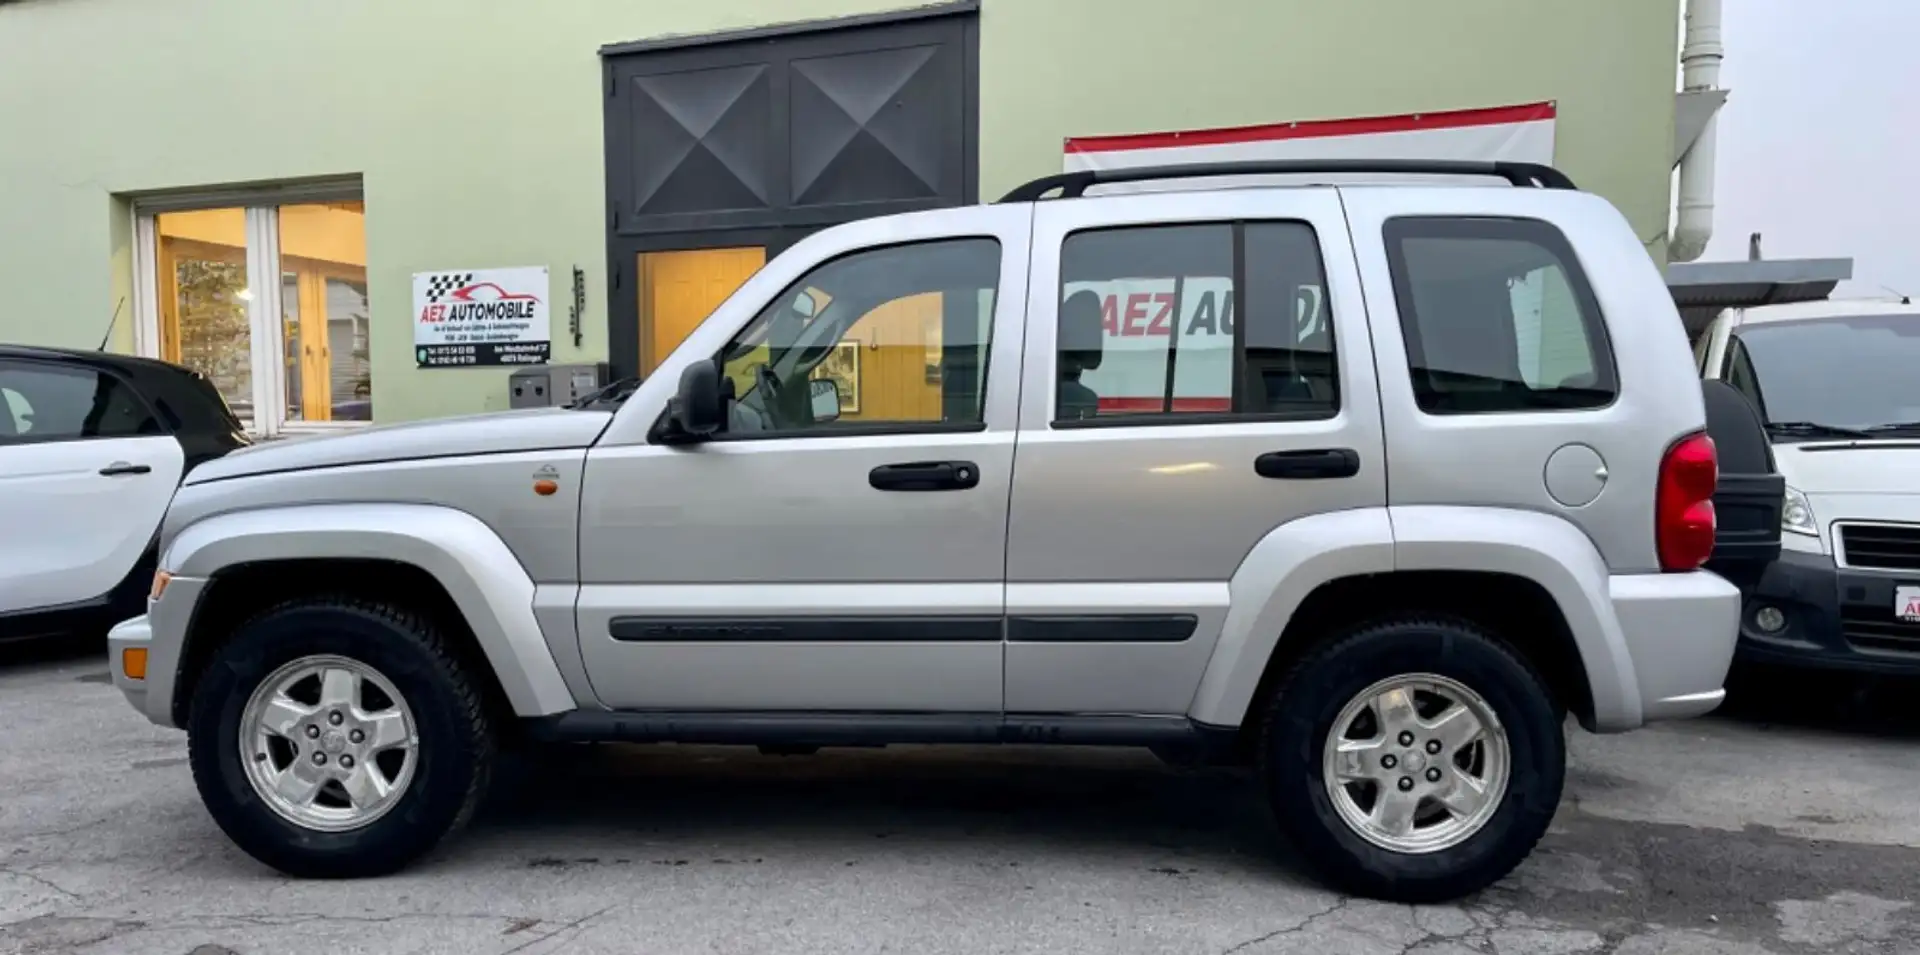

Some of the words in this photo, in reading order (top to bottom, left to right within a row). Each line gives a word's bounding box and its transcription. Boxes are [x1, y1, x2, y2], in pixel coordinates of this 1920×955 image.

[420, 305, 446, 322] AEZ
[448, 301, 535, 321] AUTOMOBILE
[1101, 292, 1176, 336] AEZ
